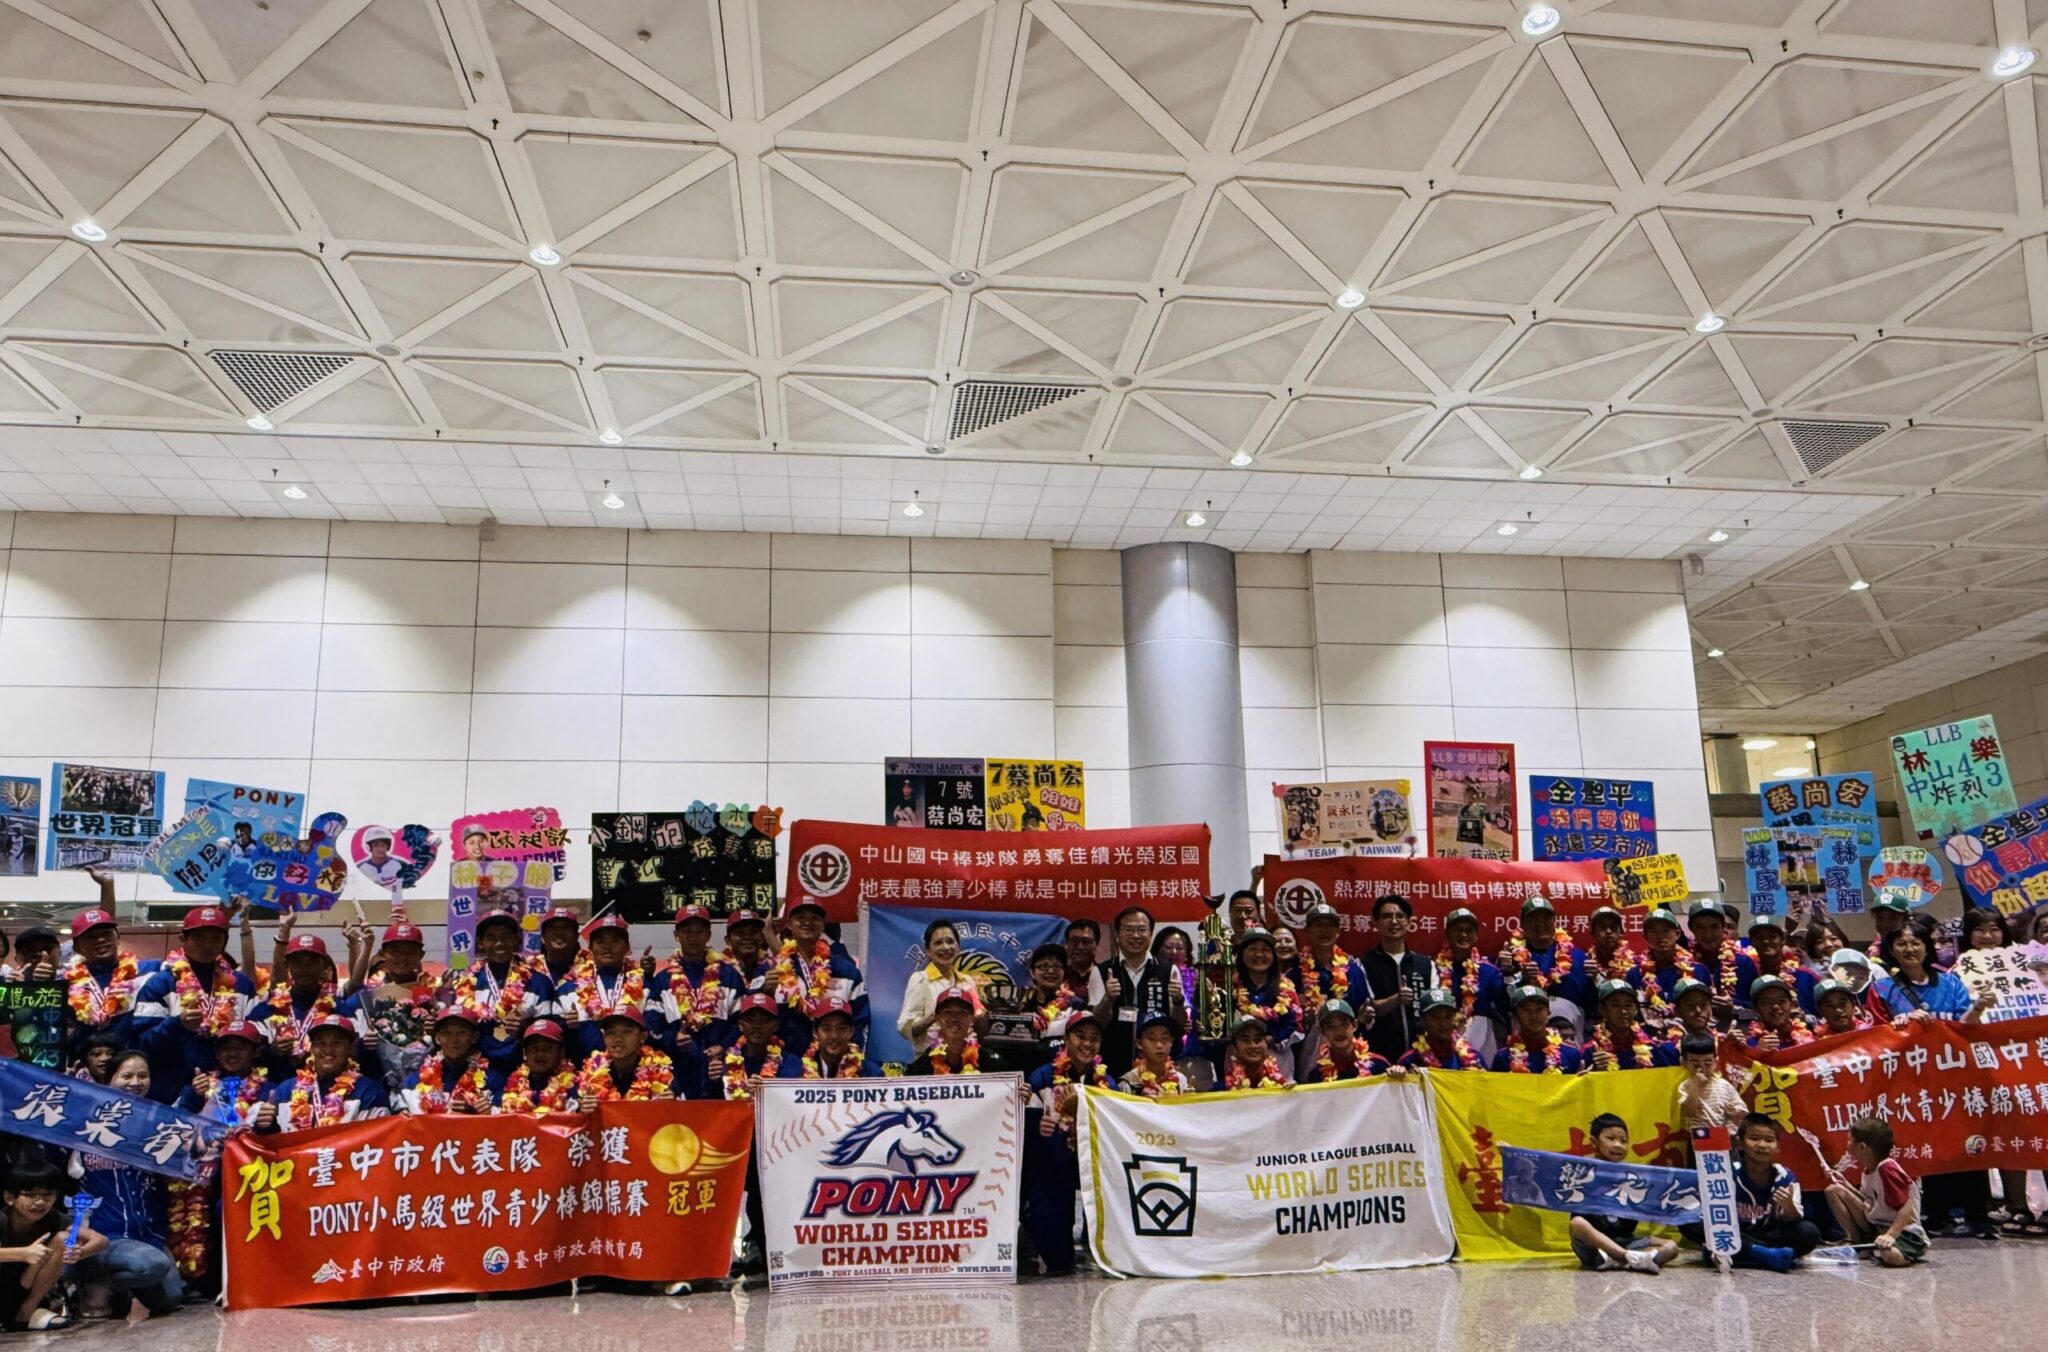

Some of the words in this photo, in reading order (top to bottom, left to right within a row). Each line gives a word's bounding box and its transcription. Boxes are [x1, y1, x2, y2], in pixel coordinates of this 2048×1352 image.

[1923, 724, 1962, 747] LLB
[1901, 748, 1931, 775] 林
[233, 787, 295, 808] PONY
[1764, 778, 1869, 815] 蔡尚宏
[49, 813, 162, 837] 世界冠軍
[928, 805, 984, 827] 蔡尚宏
[860, 844, 1200, 868] 中山國中棒球隊勇奪佳績光榮返國
[1308, 848, 1337, 858] TEAM
[859, 878, 1008, 899] 地表最強青少棒
[1014, 878, 1200, 899] 就是中山國中棒球隊
[1334, 879, 1543, 900] 熱烈歡迎中山國中棒球隊
[452, 896, 472, 951] 世界
[794, 1089, 837, 1104] 2025
[842, 1088, 888, 1103] PONY
[893, 1085, 985, 1102] BASEBALL
[1739, 1060, 1798, 1134] 賀
[1135, 1132, 1176, 1147] 2025
[1990, 1135, 2048, 1153] 臺中市
[308, 1136, 542, 1188] 臺中市代表隊
[567, 1126, 633, 1168] 榮獲
[1256, 1153, 1308, 1167] JUNIOR
[1310, 1146, 1358, 1163] LEAGUE
[1360, 1142, 1416, 1158] BASEBALL
[1246, 1171, 1339, 1201] WORLD
[1347, 1160, 1427, 1192] SERIES
[234, 1156, 294, 1243] 賀
[308, 1178, 649, 1237] PONY小馬級世界青少棒錦標賽
[667, 1179, 717, 1216] 冠軍
[800, 1170, 980, 1221] PONY
[1702, 1153, 1737, 1252] 歡迎回家
[1275, 1195, 1407, 1236] CHAMPIONS
[794, 1222, 888, 1245] WORLD
[896, 1218, 989, 1241] SERIES
[349, 1253, 446, 1278] 臺中市政府
[514, 1236, 643, 1269] 臺中市政府教育局
[821, 1244, 962, 1266] CHAMPION
